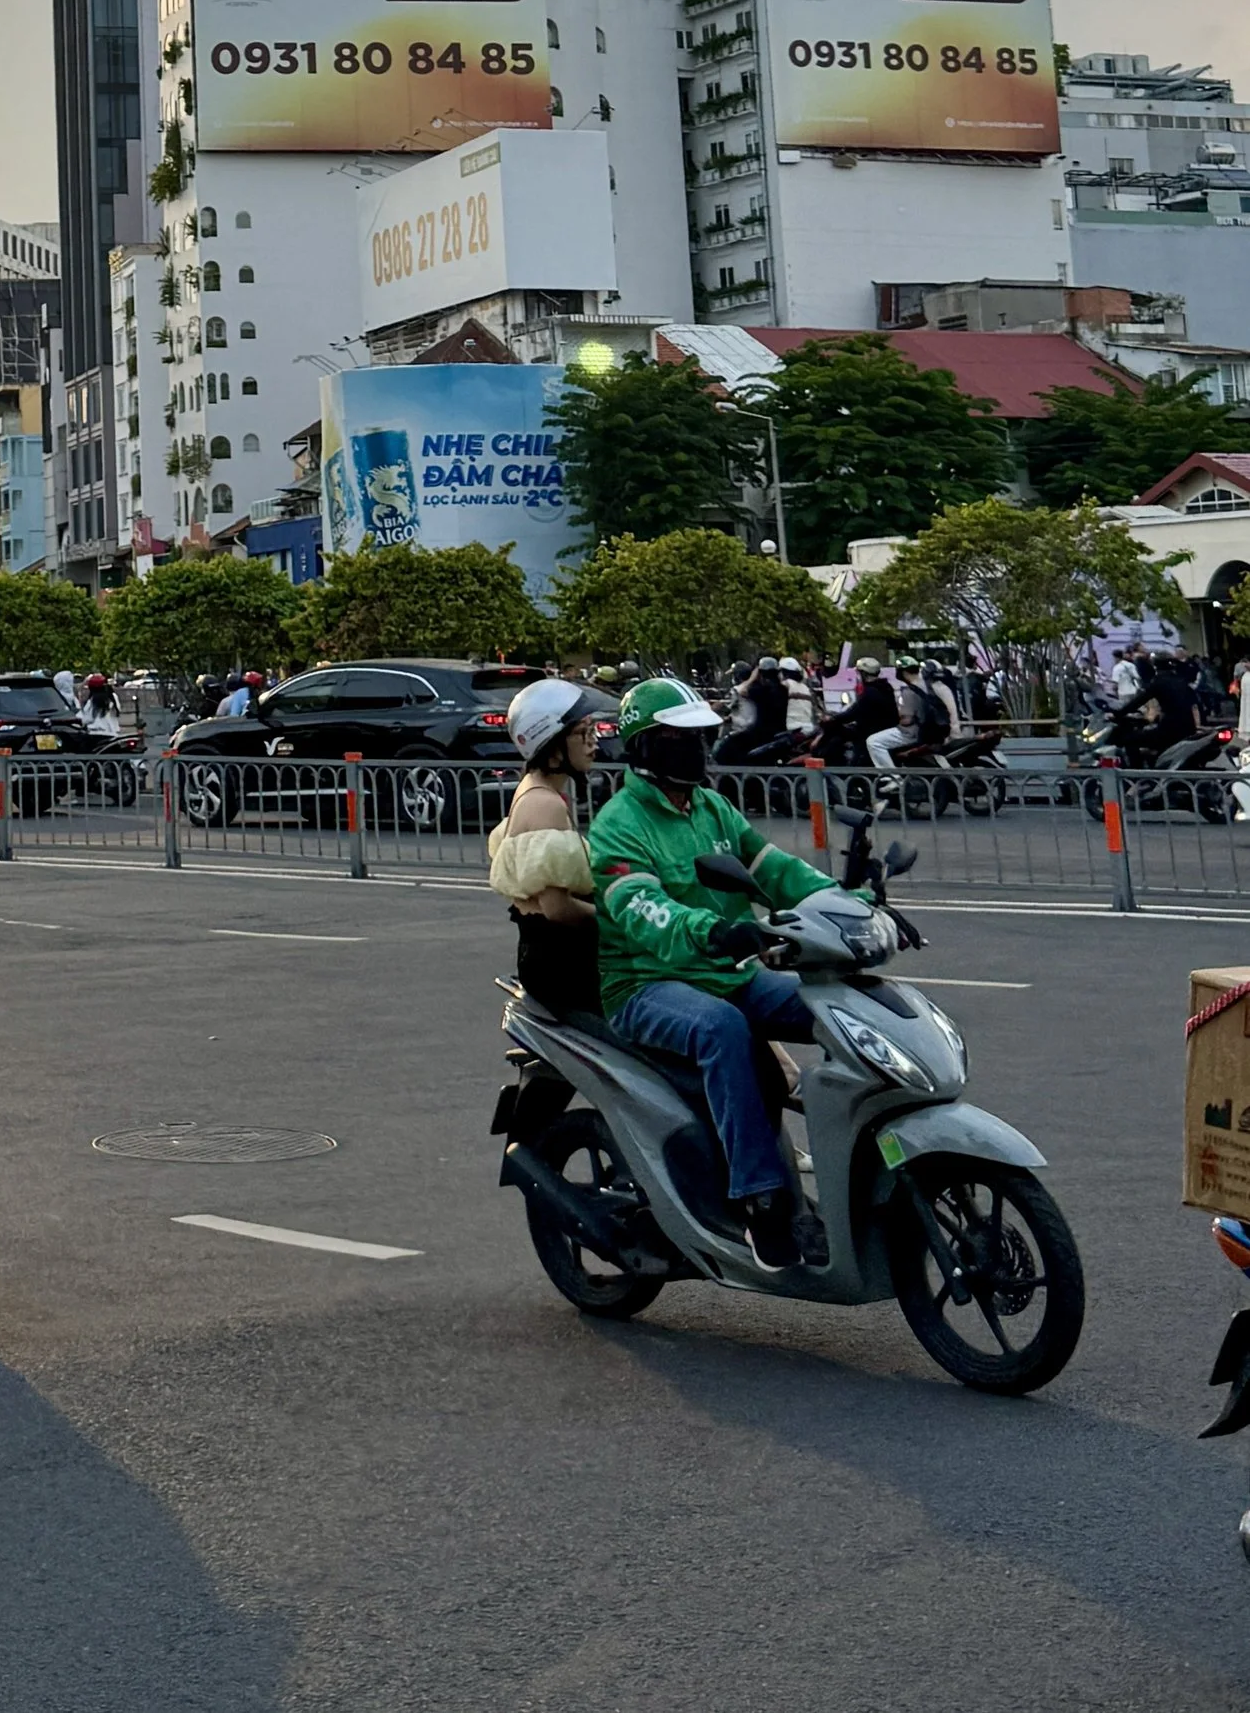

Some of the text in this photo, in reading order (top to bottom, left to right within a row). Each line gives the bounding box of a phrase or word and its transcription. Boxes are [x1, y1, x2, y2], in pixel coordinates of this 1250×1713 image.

[211, 42, 535, 76] 0931 80 84 85
[788, 39, 1038, 76] 0931 80 84 85
[373, 191, 489, 287] 0986 27 28 28
[422, 434, 568, 462] NHẸ CHIL
[423, 458, 495, 493] ĐẬM
[423, 494, 449, 508] LỌC
[451, 494, 489, 507] LẠNH
[491, 491, 520, 505] SÂU
[369, 523, 419, 546] AIGO
[384, 516, 405, 528] BIA
